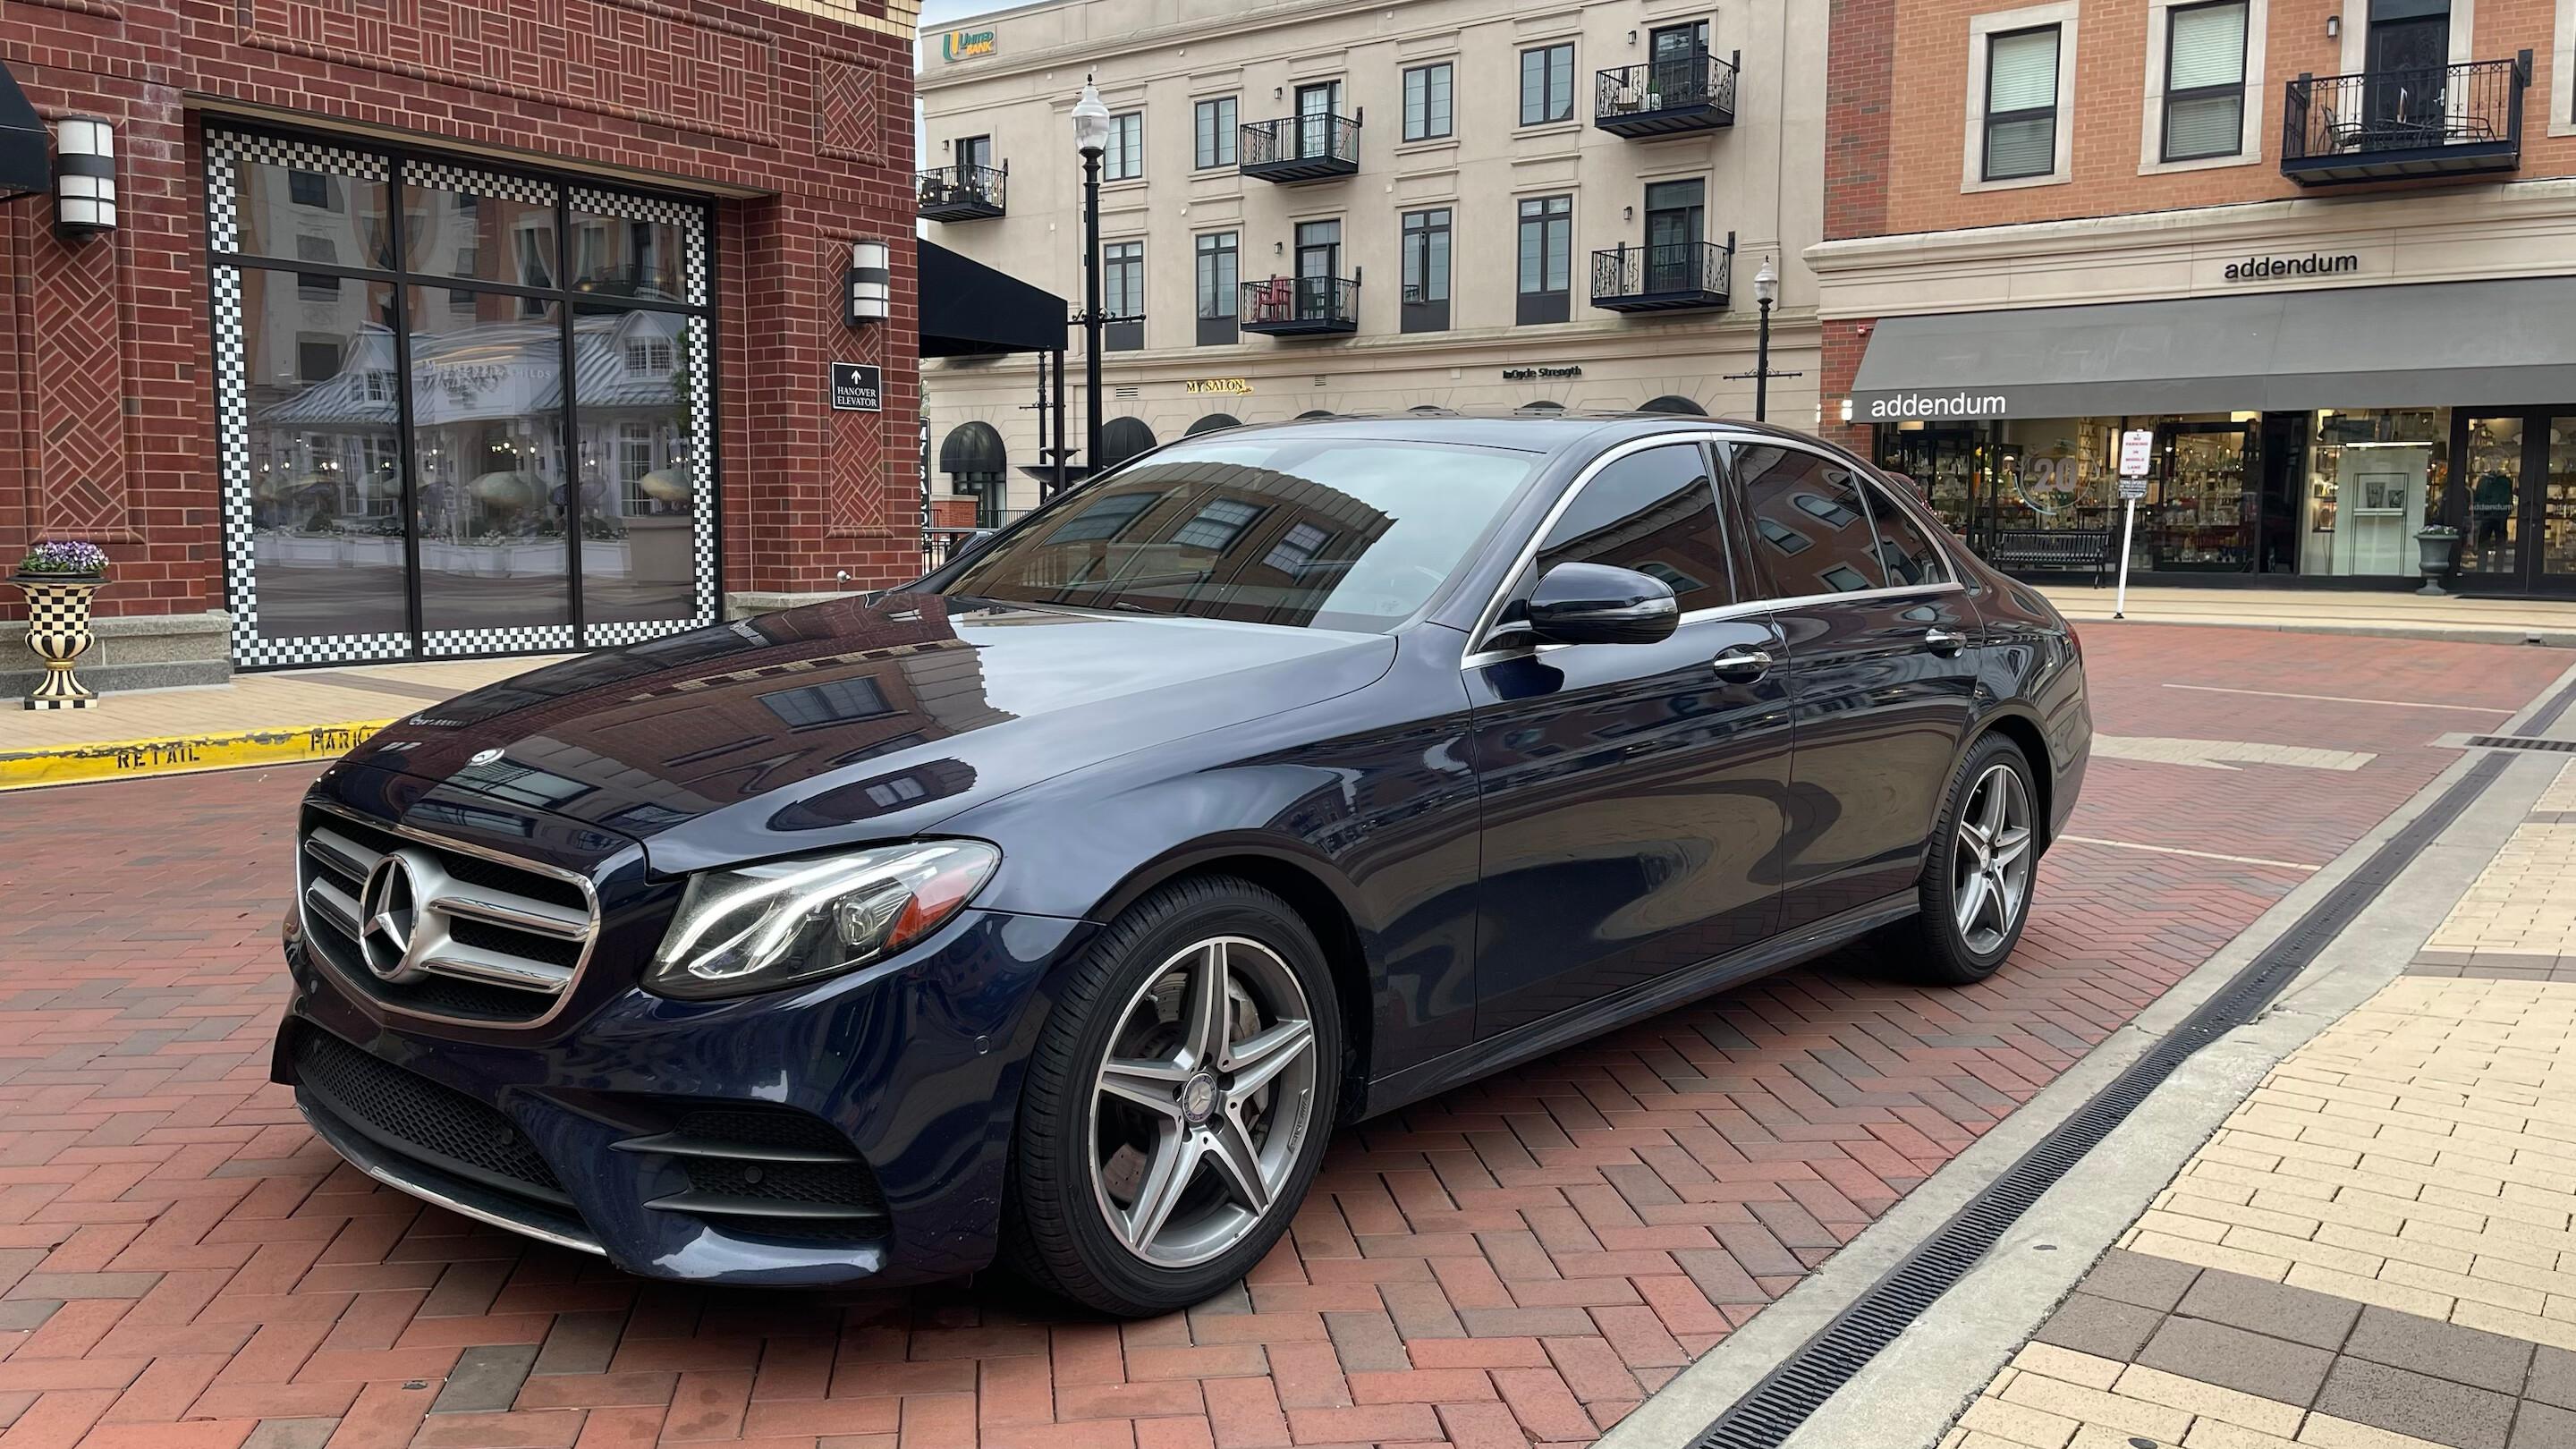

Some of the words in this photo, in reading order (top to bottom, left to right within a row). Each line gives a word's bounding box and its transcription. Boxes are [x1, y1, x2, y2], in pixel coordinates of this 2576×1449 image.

[960, 31, 994, 46] UNITED
[967, 41, 992, 55] BANK
[2224, 253, 2358, 278] addendum
[1538, 366, 1581, 377] Strength
[837, 386, 877, 397] HANOVER
[1187, 380, 1204, 394] MY
[1206, 379, 1245, 393] SALON
[837, 396, 877, 407] ELEVATOR
[1871, 392, 2005, 417] addendum
[2034, 458, 2077, 493] 20
[118, 746, 199, 768] RETAIL
